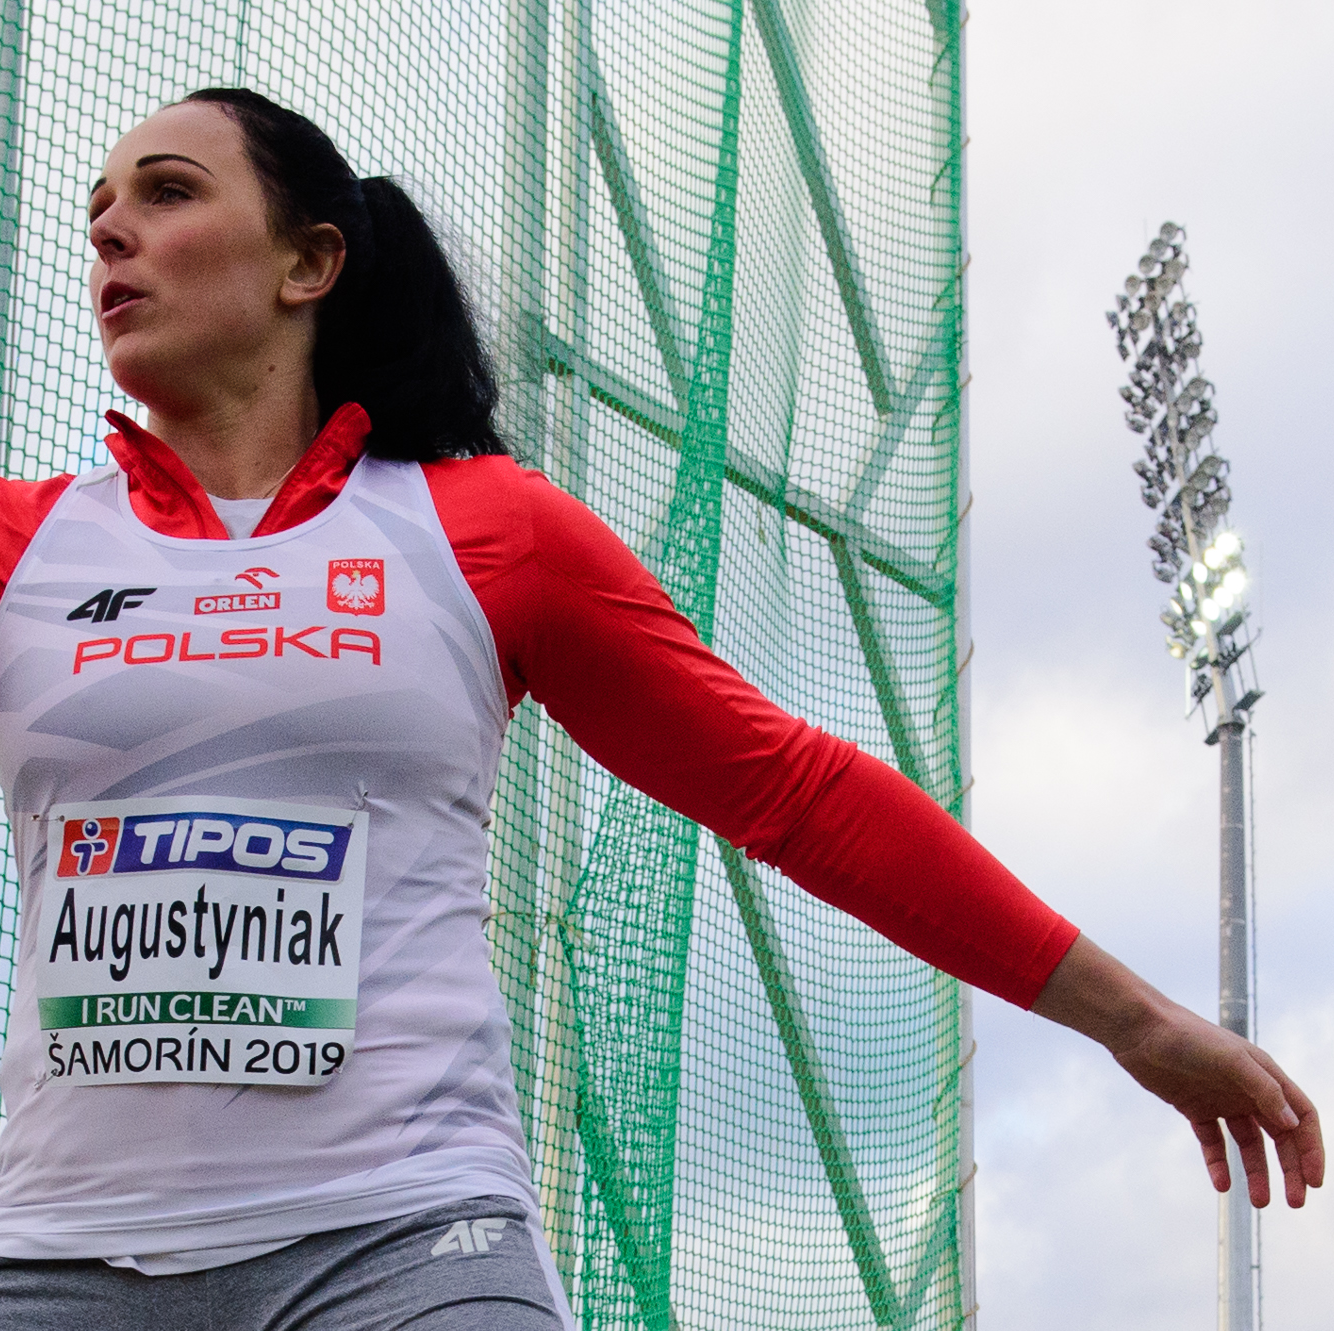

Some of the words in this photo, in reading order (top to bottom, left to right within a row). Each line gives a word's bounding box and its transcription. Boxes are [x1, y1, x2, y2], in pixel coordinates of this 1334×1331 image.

[332, 561, 381, 569] POLSKA
[197, 594, 276, 614] ORLEN
[72, 626, 382, 674] POLSKA
[134, 819, 335, 873] TIPOS
[48, 883, 344, 981] Augustyniak
[81, 998, 89, 1024] I
[97, 995, 161, 1023] RUN
[48, 1026, 231, 1078] ŠAMORÍN
[244, 1039, 346, 1076] 2019
